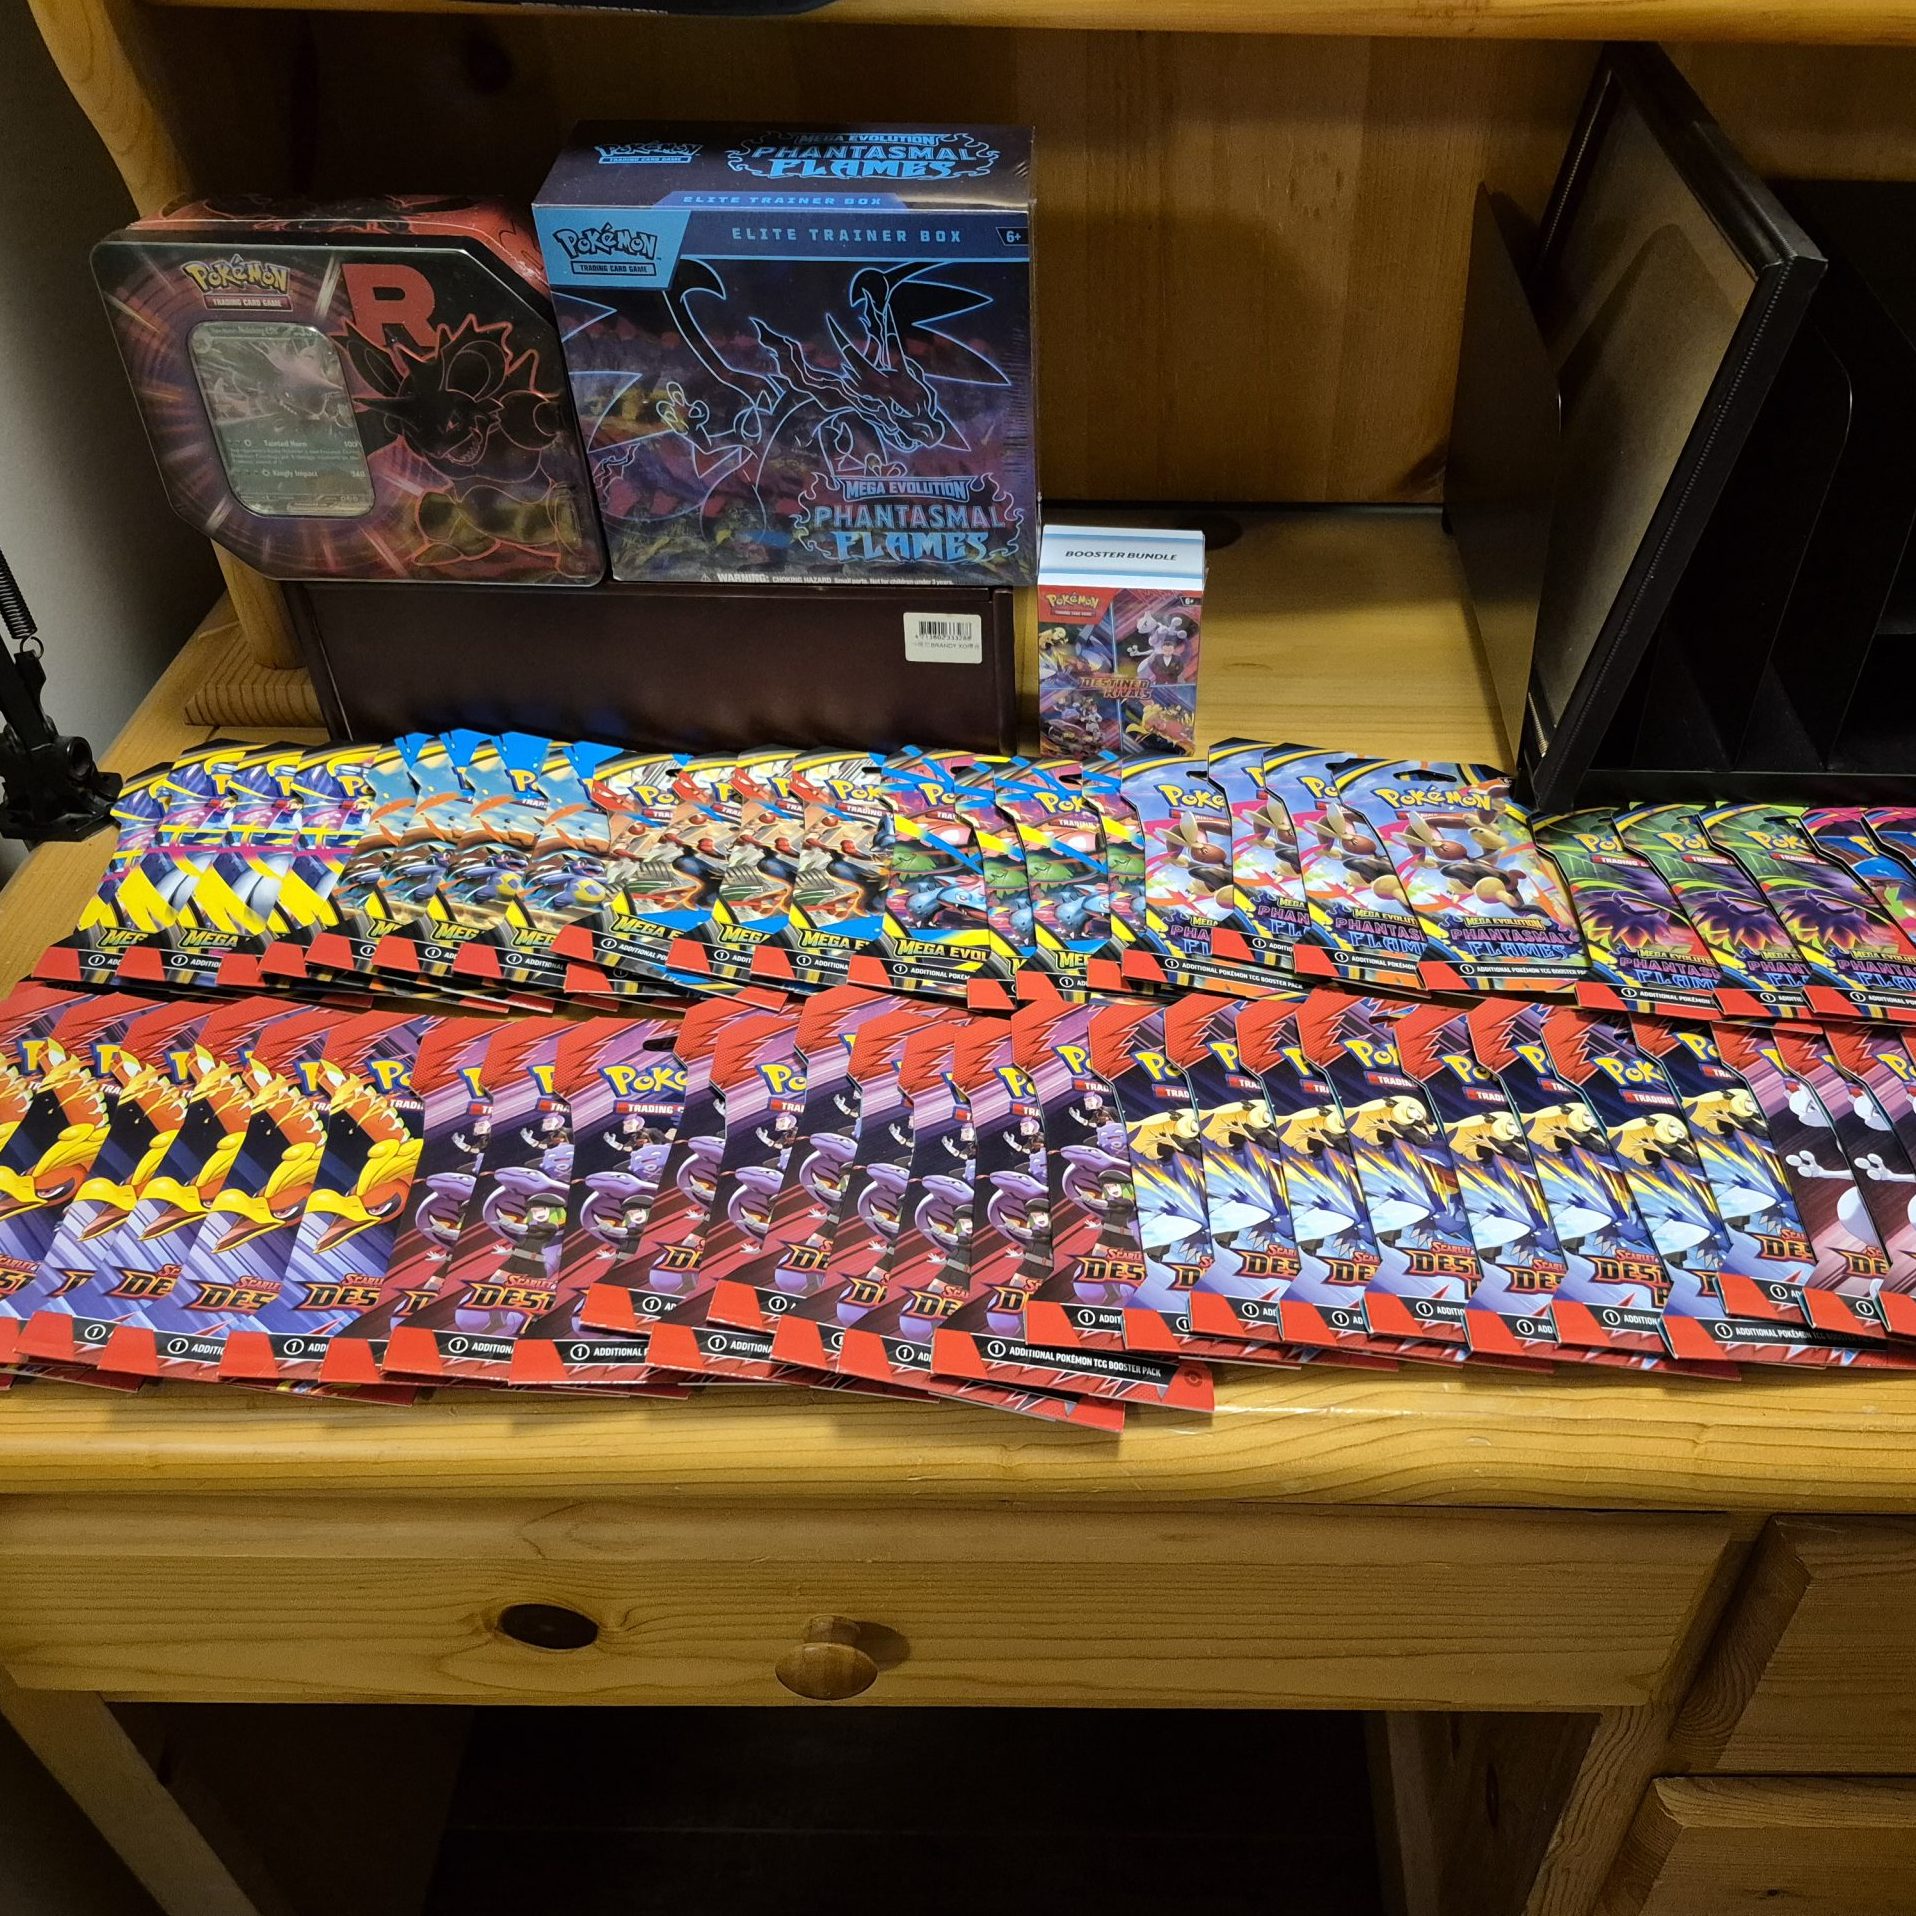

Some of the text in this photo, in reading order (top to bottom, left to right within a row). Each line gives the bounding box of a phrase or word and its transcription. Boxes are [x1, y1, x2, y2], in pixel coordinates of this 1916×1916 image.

[848, 134, 936, 145] EVOLUTION
[751, 145, 977, 161] PHANTASMAL
[767, 158, 959, 179] FLAMES
[683, 196, 882, 205] ELITE TRAINER BOX
[732, 227, 961, 243] ELITE TRAINER BOX
[1005, 230, 1023, 244] 6+
[580, 264, 648, 274] TRADING CARD GAME
[213, 297, 282, 308] TRADING CARD GAME
[342, 263, 440, 352] R
[846, 480, 967, 499] MEGA EVOLUTION
[814, 504, 1006, 529] PHANTASMAL
[830, 530, 990, 562] FLAMES
[1065, 550, 1178, 561] BOOSTER BUNDLE
[717, 573, 770, 583] WARNING:
[1080, 677, 1151, 689] DESTINED
[1104, 688, 1152, 699] RIVALS
[1601, 857, 1638, 867] TRADING
[1354, 908, 1379, 919] MEGA
[613, 917, 667, 936] MEGA
[1465, 917, 1545, 930] MEGA EVOLUTION
[183, 930, 238, 948] MEGA
[803, 930, 851, 949] MEGA
[1450, 929, 1573, 946] PHANTASMAL
[618, 943, 655, 957] ADDITIONAL
[897, 940, 946, 957] MEGA
[1467, 942, 1567, 960] FLAMES
[1640, 949, 1668, 959] MEGA
[1762, 950, 1789, 960] MEGA
[1852, 950, 1880, 960] MEGA
[1352, 955, 1386, 967] ADDITIONAL
[910, 967, 947, 979] ADDITIONAL
[1182, 961, 1217, 974] ADDITIONAL
[1218, 966, 1249, 980] POKÉMON
[1249, 972, 1261, 982] TCG
[1261, 975, 1287, 988] BOOSTER
[1477, 966, 1511, 975] ADDITIONAL
[1511, 966, 1540, 976] POKÉMON
[1639, 990, 1678, 1001] ADDITIONAL
[1678, 994, 1711, 1005] POKÉMON
[1868, 994, 1905, 1006] ADDITIONAL
[1634, 1094, 1675, 1106] TRADING
[628, 1103, 671, 1114] TRADING
[1431, 1241, 1470, 1255] SCARLET
[1616, 1249, 1655, 1263] SCARLET
[504, 1274, 550, 1289] SCARLET
[1736, 1327, 1777, 1337] ADDITIONAL
[1777, 1329, 1812, 1340] POKÉMON
[593, 1347, 643, 1357] ADDITIONAL
[1009, 1346, 1055, 1361] ADDITIONAL
[1055, 1350, 1093, 1366] POKÉMON
[1094, 1358, 1108, 1369] TCG
[1108, 1360, 1142, 1374] BOOSTER
[1142, 1367, 1162, 1378] PACK
